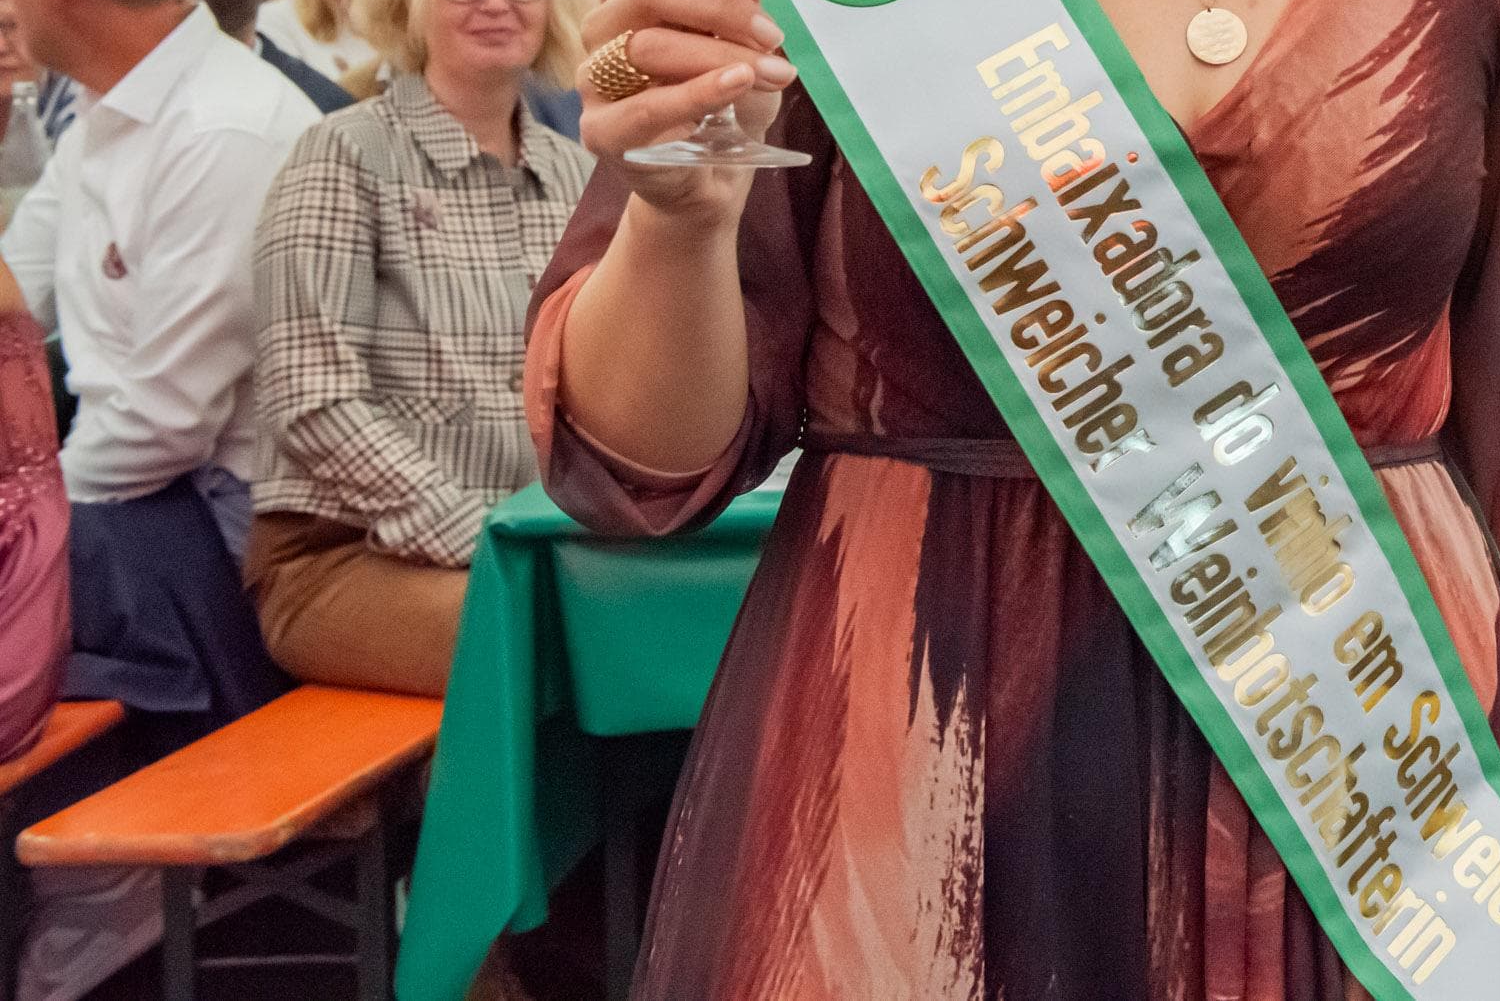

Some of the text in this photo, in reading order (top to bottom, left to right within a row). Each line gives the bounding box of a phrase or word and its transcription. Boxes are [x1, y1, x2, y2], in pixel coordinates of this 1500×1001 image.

[919, 136, 1457, 987] Schweicher Weinbotschafterin
[976, 22, 1225, 388] Embaixadora
[1193, 382, 1281, 467] do
[1243, 455, 1357, 616] vinho
[1332, 610, 1404, 714] em
